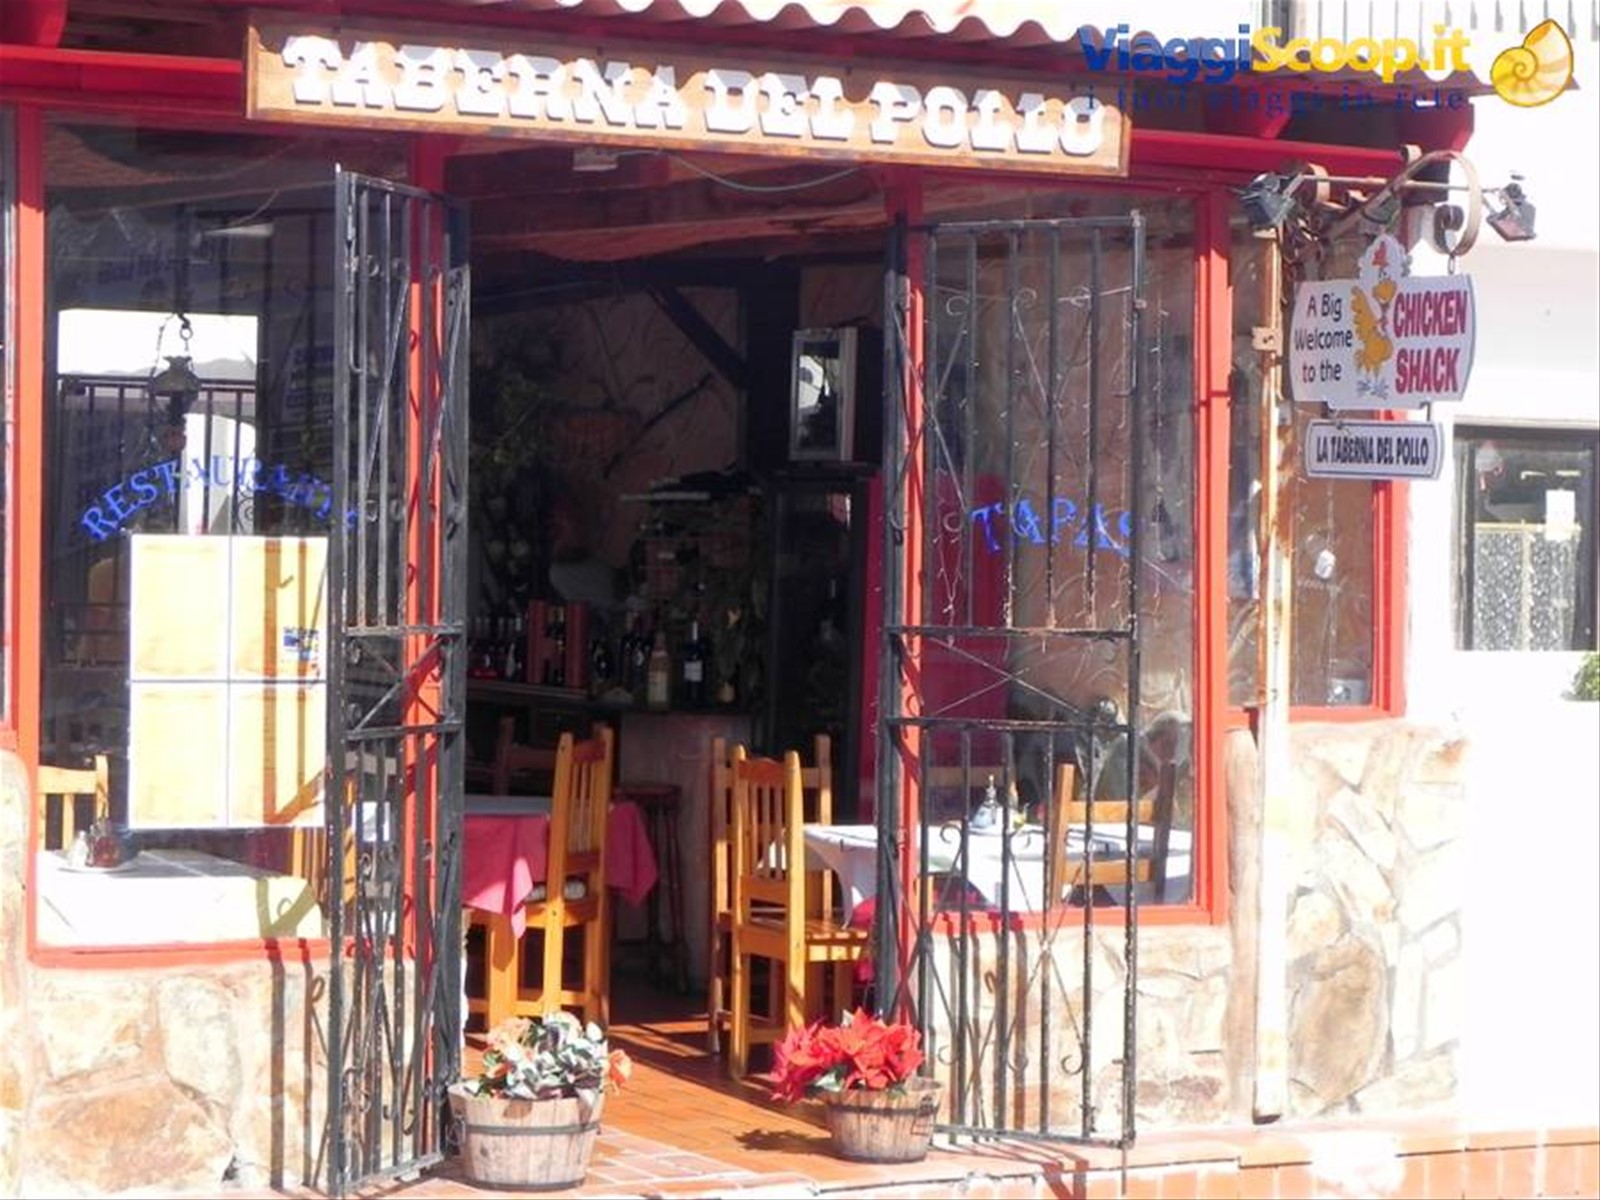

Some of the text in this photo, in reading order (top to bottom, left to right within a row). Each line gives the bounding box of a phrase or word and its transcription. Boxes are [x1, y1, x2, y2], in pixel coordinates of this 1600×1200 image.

[281, 35, 1105, 156] TABERNA DEL POLLO
[1306, 292, 1342, 322] A Big
[1393, 290, 1468, 338] CHICKEN
[1294, 326, 1353, 351] Welcome
[1302, 359, 1342, 383] to the
[1395, 348, 1461, 394] SHACK
[1316, 436, 1429, 466] LA TABERNA DEL POLLO
[76, 454, 359, 541] RESTAURANT
